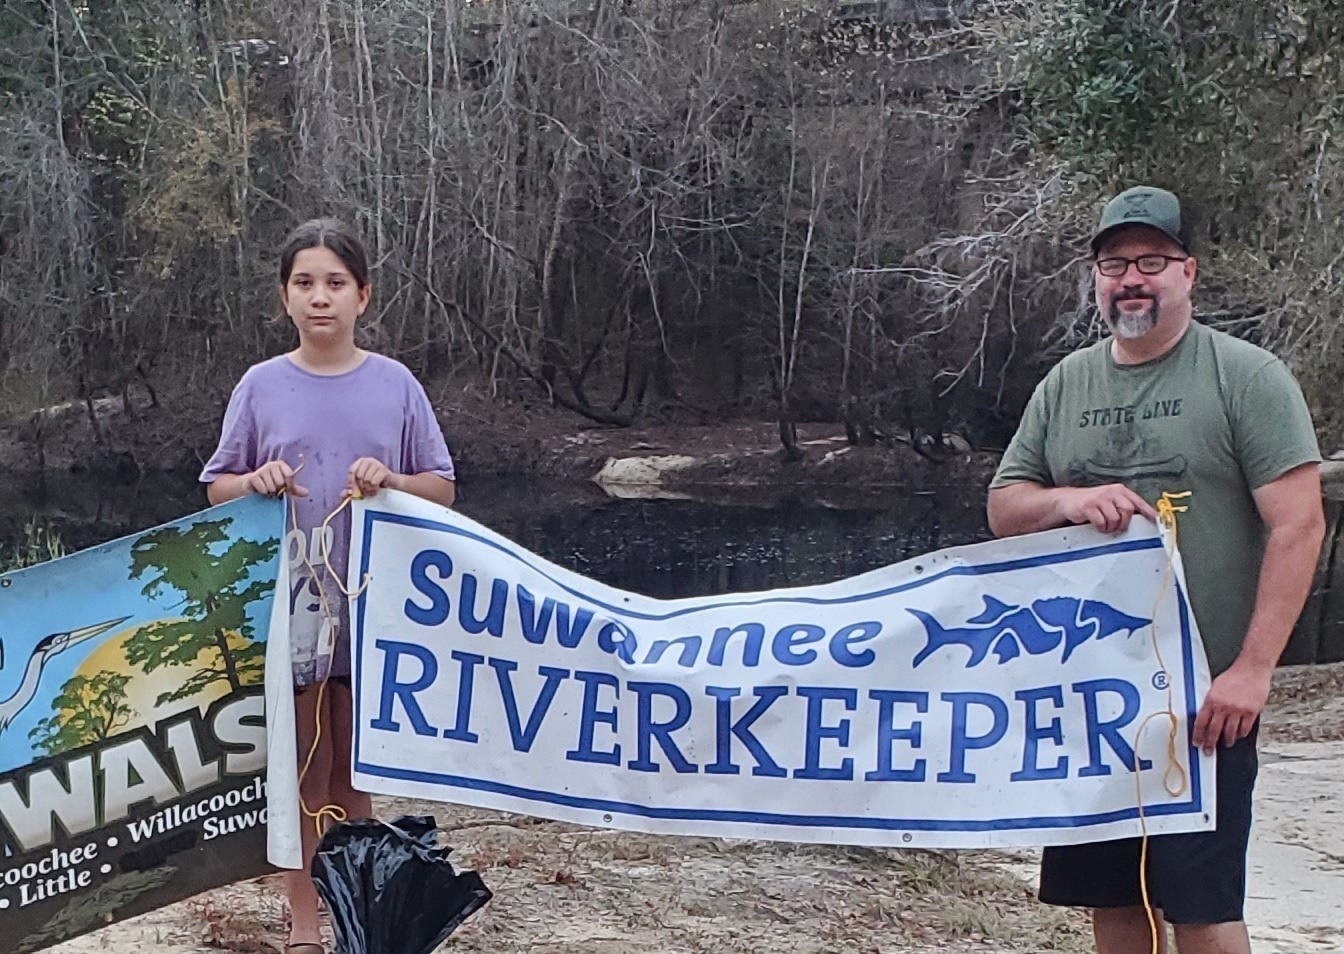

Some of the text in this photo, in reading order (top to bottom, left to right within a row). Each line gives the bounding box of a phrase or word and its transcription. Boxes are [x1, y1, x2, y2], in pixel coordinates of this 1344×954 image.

[1079, 398, 1183, 428] STATE LINE
[404, 549, 883, 667] Suwannee
[19, 868, 92, 907] Little
